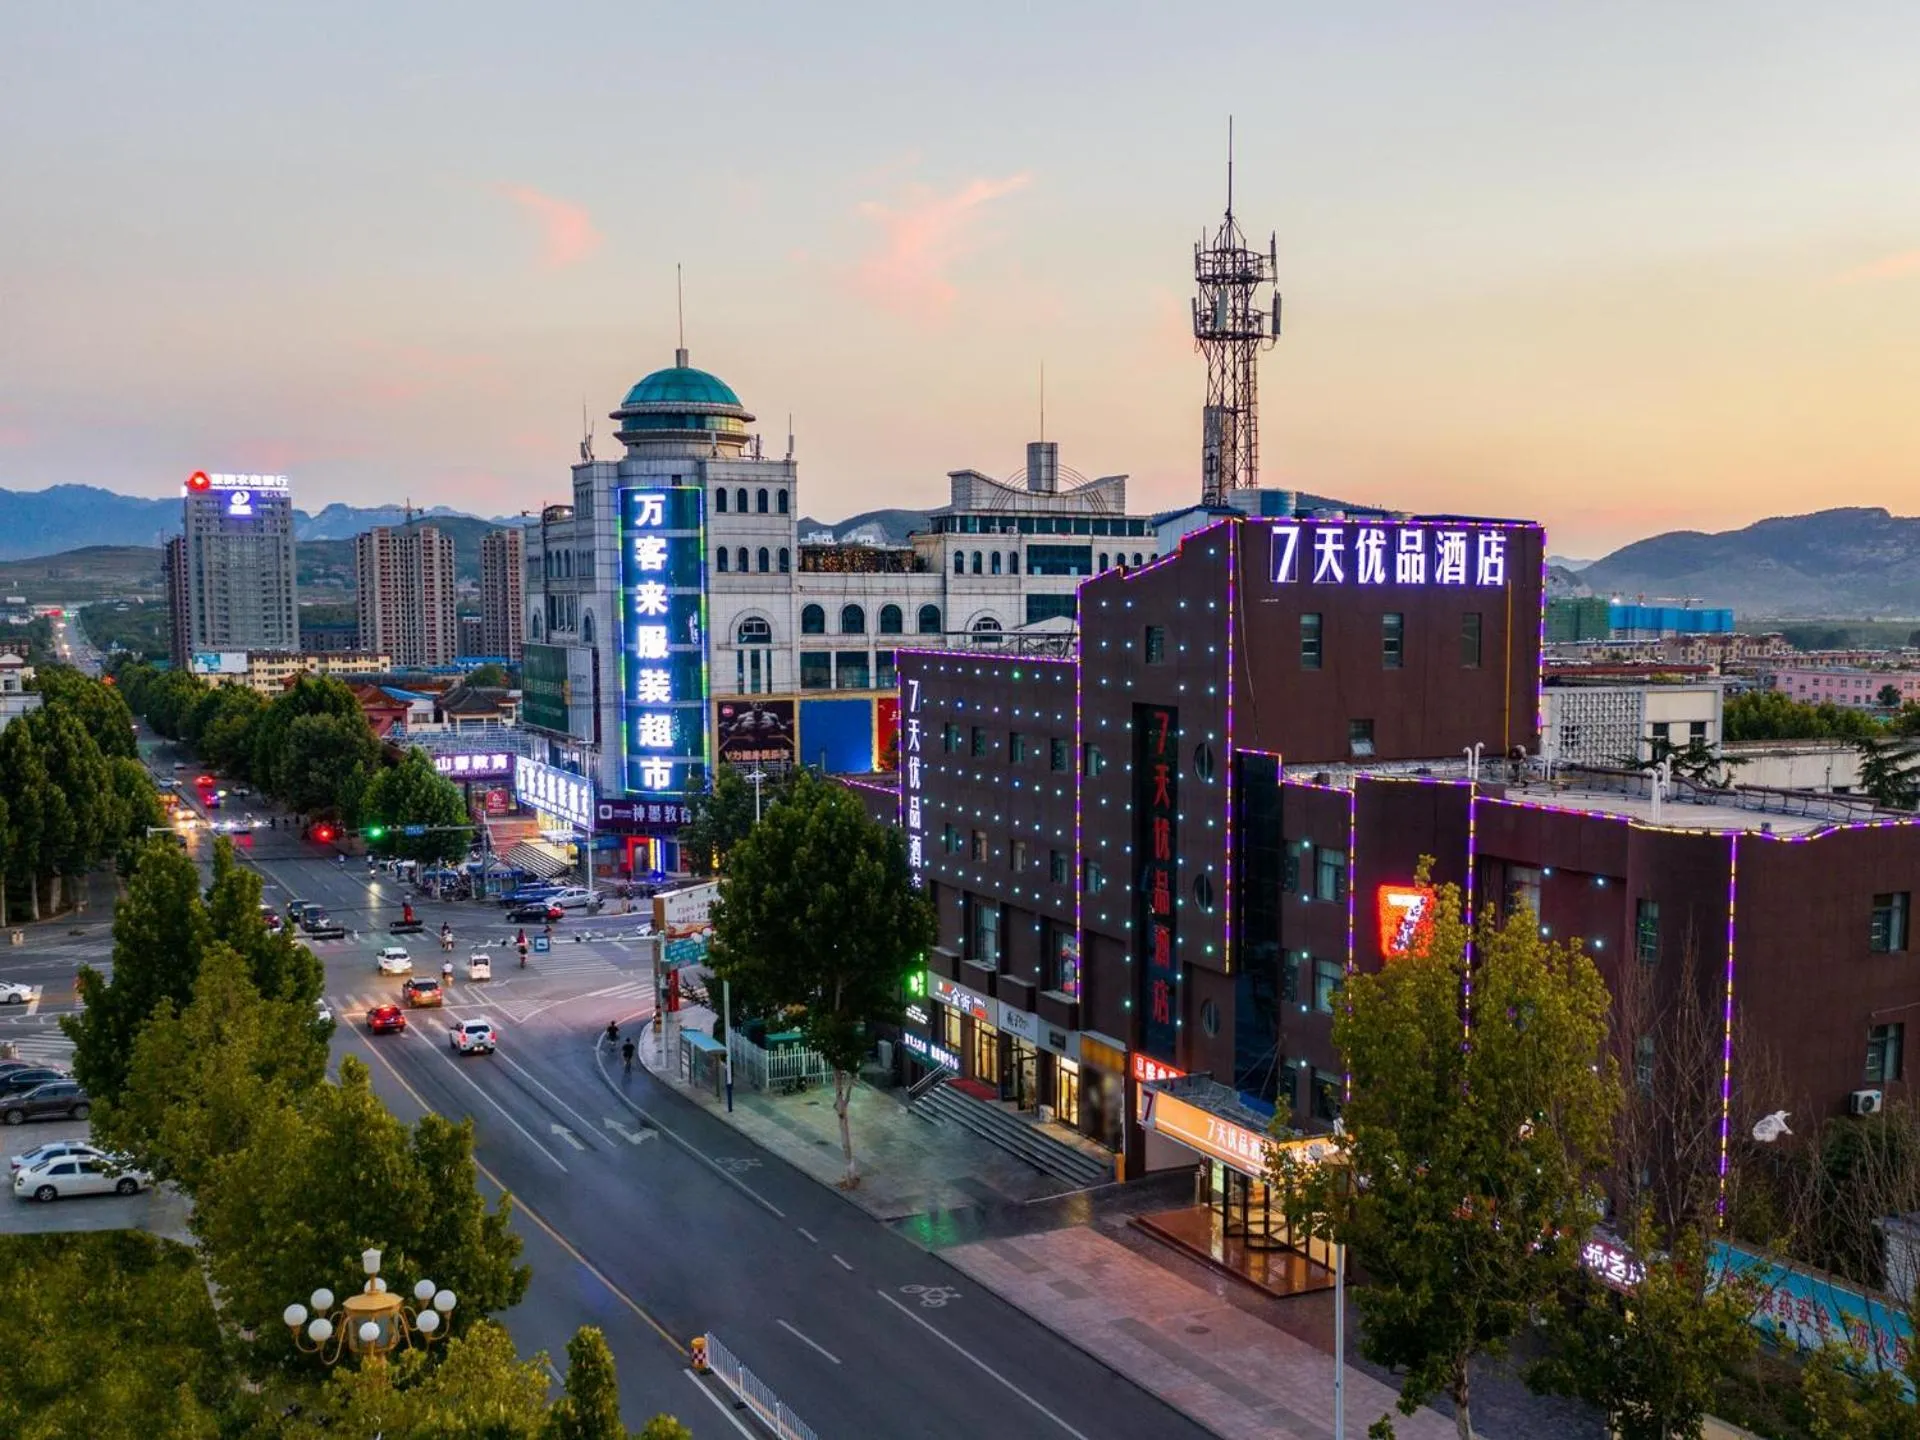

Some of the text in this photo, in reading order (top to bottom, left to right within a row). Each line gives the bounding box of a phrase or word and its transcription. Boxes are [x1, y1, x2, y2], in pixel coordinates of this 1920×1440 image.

[634, 493, 674, 791] 万客来服装超市
[1270, 525, 1508, 586] 7天优品酒店
[1152, 711, 1171, 1025] 7天优品酒店
[1387, 893, 1428, 951] 7
